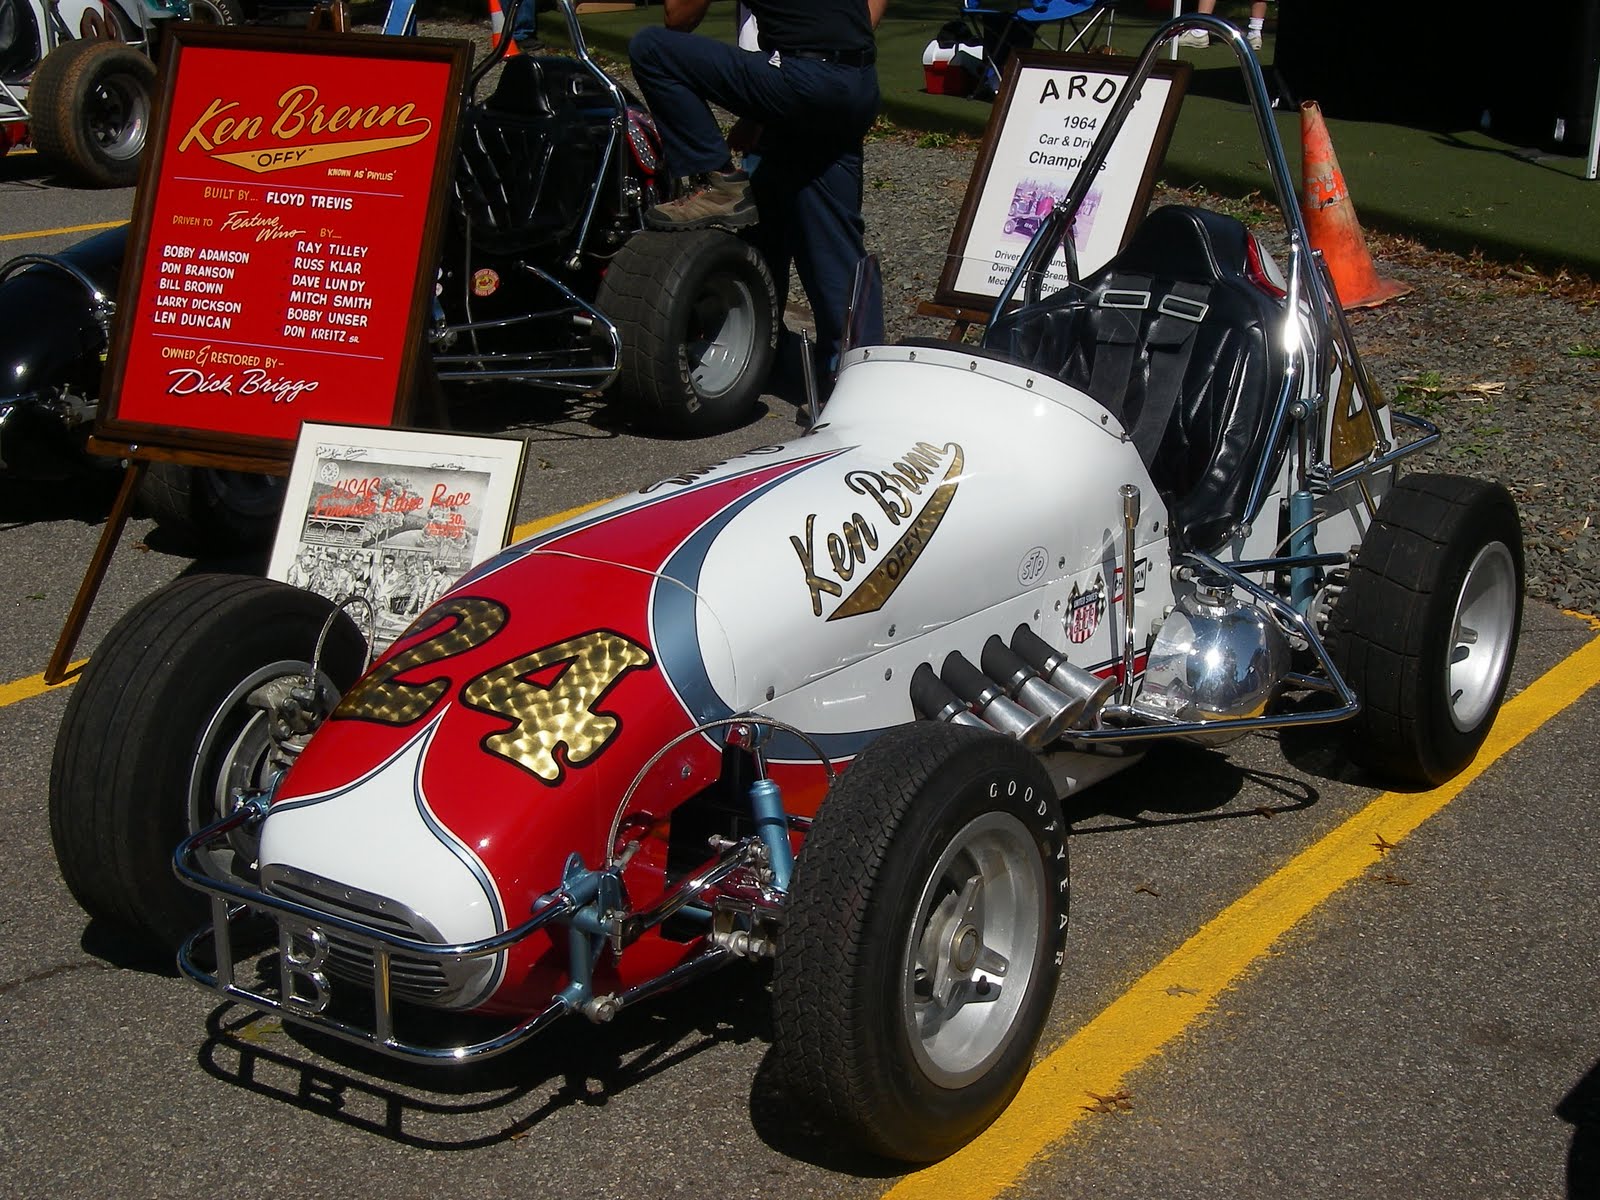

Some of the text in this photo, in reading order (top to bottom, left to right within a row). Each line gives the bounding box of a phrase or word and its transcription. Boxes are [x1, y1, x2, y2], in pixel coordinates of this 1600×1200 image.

[1039, 75, 1142, 109] ARD
[178, 85, 420, 153] Ken Brenn
[1063, 115, 1098, 131] 1964
[1039, 133, 1060, 146] Car
[1061, 135, 1071, 147] &
[250, 147, 314, 167] "OFFY"
[1029, 151, 1108, 171] Champis
[327, 168, 352, 178] KNOWN
[353, 169, 365, 179] AS
[204, 186, 235, 200] BUILT
[266, 191, 305, 207] FLOYD
[311, 195, 353, 210] TREVIS
[172, 215, 200, 226] DRIVEN
[202, 218, 213, 227] TO
[220, 210, 280, 232] Feature
[163, 245, 250, 264] BOBBY ADAMSON
[297, 240, 368, 258] RAY TILLEY
[161, 261, 235, 280] DON BRANSON
[294, 256, 362, 275] RUSS KLAR
[159, 278, 224, 295] BILL BROWN
[292, 274, 366, 293] DAVE LUNDY
[156, 294, 242, 314] LARRY DICKSON
[289, 290, 372, 310] MITCH SMITH
[154, 310, 232, 330] LEN DUNCAN
[287, 307, 368, 328] BOBBY UNSER
[283, 324, 306, 338] DON
[311, 327, 347, 342] KREITZ
[161, 346, 196, 360] OWNED
[195, 345, 212, 367] &
[210, 352, 261, 367] RESTORED
[168, 368, 320, 403] Dick Briggs
[333, 477, 381, 499] USAC
[430, 484, 471, 508] Race
[789, 441, 952, 617] Ken Brenn
[877, 518, 926, 581] "OFFY"
[1021, 551, 1046, 580] STP
[331, 596, 654, 787] 24
[989, 780, 1069, 966] GOODYEAR
